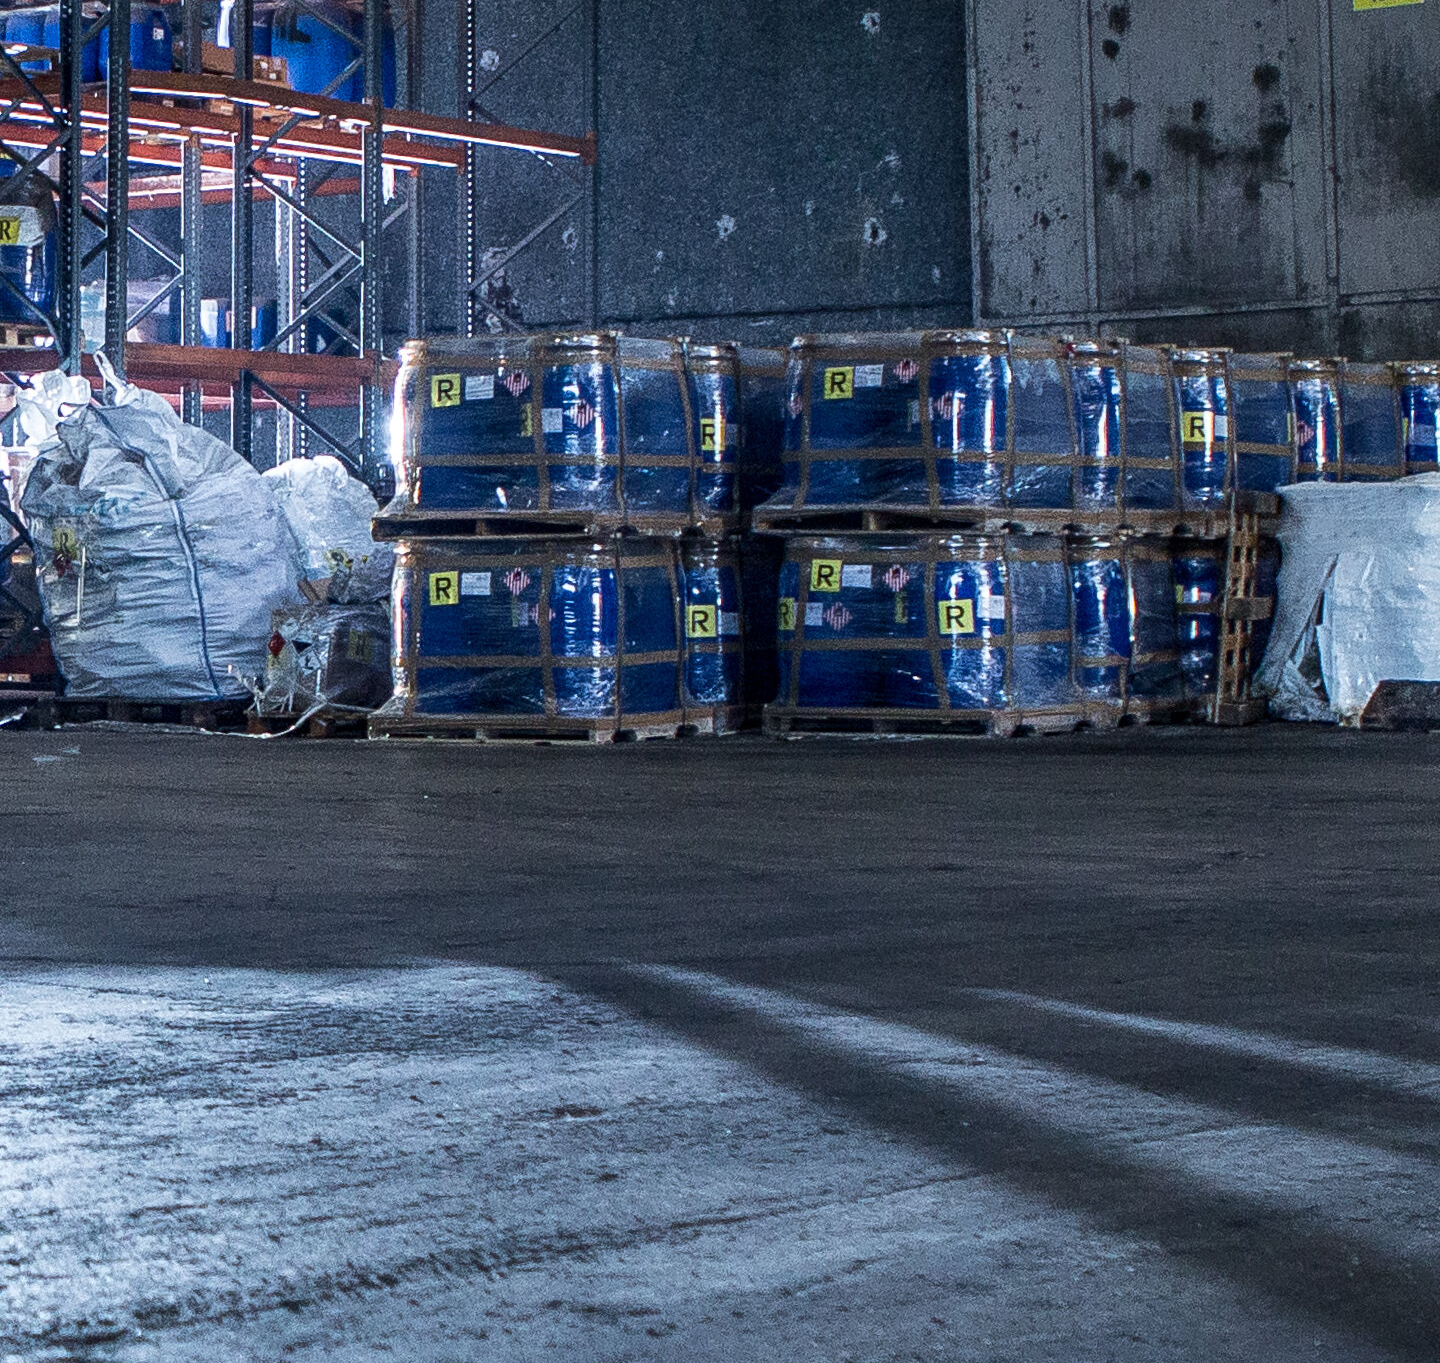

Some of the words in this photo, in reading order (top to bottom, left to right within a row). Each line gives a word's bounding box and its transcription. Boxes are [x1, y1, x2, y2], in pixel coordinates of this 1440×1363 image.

[0, 219, 12, 240] R
[436, 379, 454, 402] R
[830, 372, 847, 394] R
[702, 423, 715, 446] R
[1190, 416, 1206, 438] R
[816, 563, 835, 588] R
[435, 577, 452, 601] R
[691, 610, 709, 633] R
[945, 605, 965, 629] R
